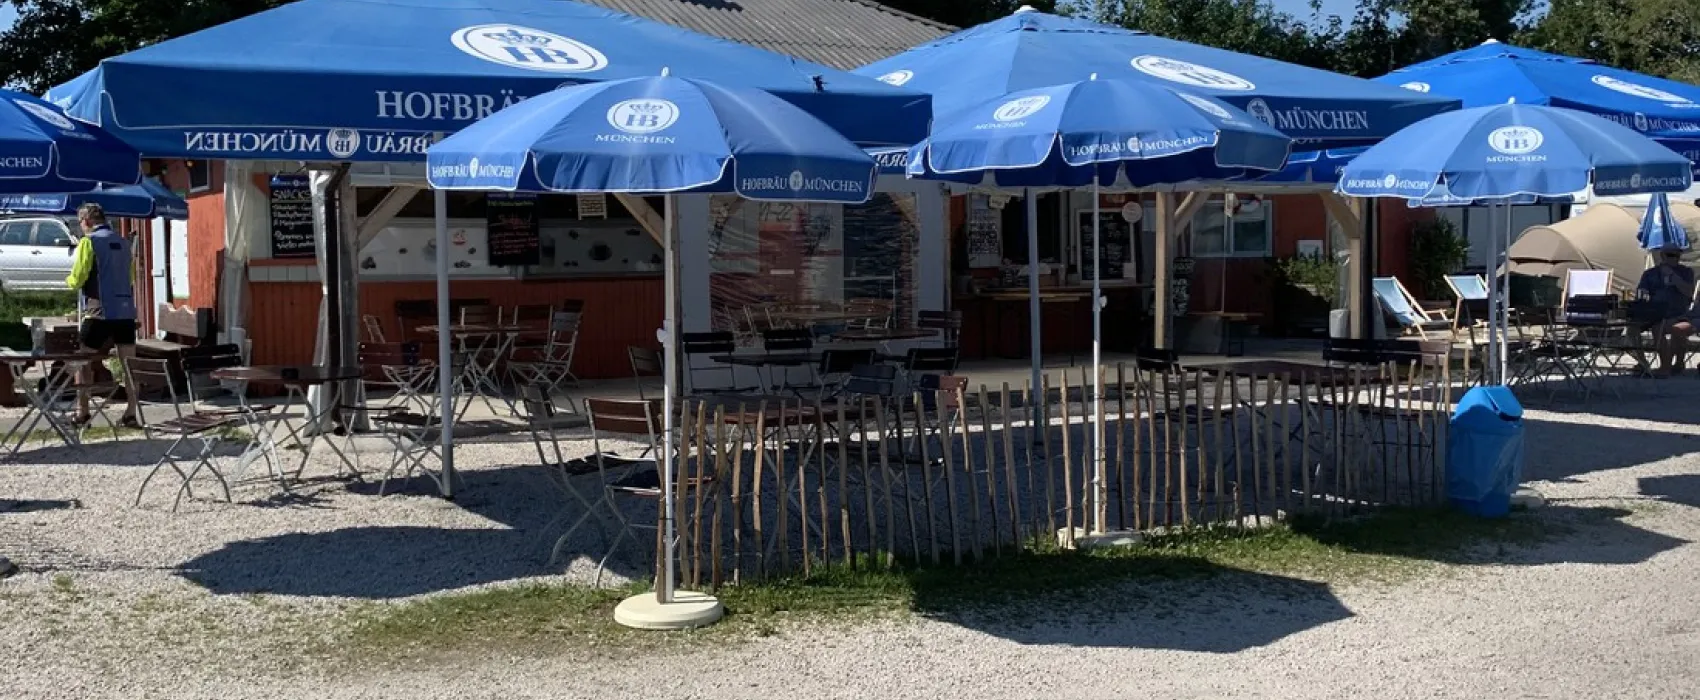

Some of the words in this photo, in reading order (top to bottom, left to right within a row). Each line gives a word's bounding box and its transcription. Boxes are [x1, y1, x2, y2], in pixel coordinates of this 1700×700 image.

[501, 46, 579, 65] HB
[375, 89, 530, 121] HOFBRÄ
[625, 114, 659, 127] HB
[1277, 107, 1369, 130] MÜNCHEN
[594, 134, 676, 144] MÜNCHEN
[1144, 136, 1208, 151] MÜNCHEN
[1486, 154, 1548, 162] MÜNCHEN
[742, 176, 787, 190] HOFBRÄU
[804, 177, 862, 193] MÜNCHEN
